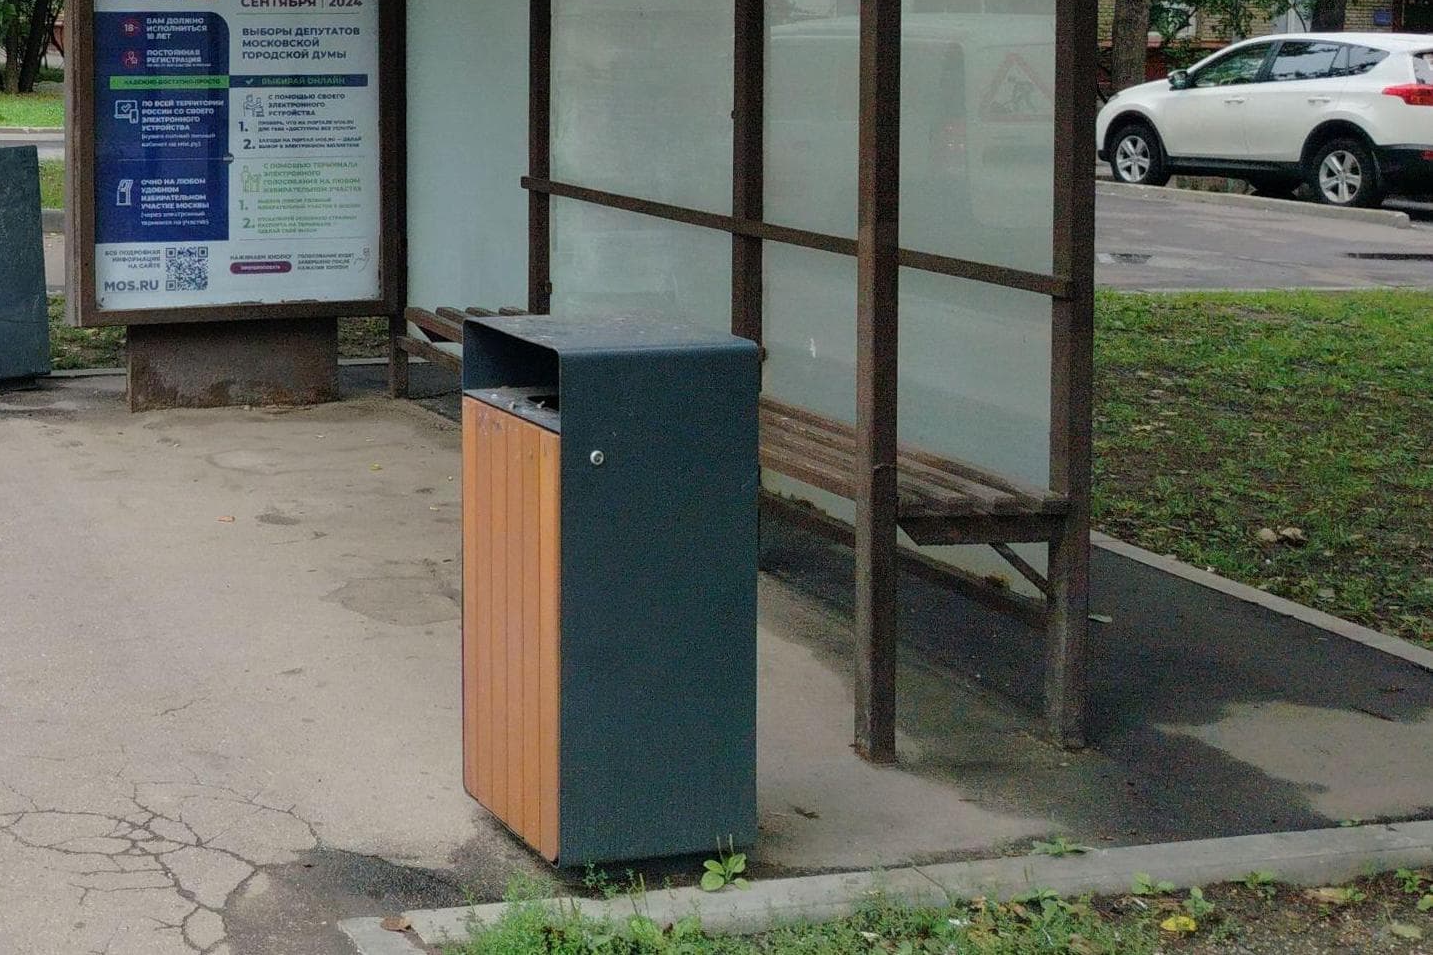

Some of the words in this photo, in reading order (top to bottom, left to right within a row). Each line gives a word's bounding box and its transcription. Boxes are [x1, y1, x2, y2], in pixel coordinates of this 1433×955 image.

[242, 28, 292, 36] ВЫБОРЫ
[295, 27, 360, 36] ДЕПУТАТОВ
[242, 37, 320, 48] МОСКОВСКОЙ
[242, 49, 309, 60] ГОРОДСКОЙ
[312, 50, 346, 60] ДУМЫ
[146, 56, 202, 64] РЕГИСТРАЦИЯ
[238, 122, 248, 132] 1.
[243, 139, 256, 150] 2.
[238, 200, 248, 210] 1.
[243, 218, 255, 228] 2.
[104, 280, 159, 292] MOS.RU
